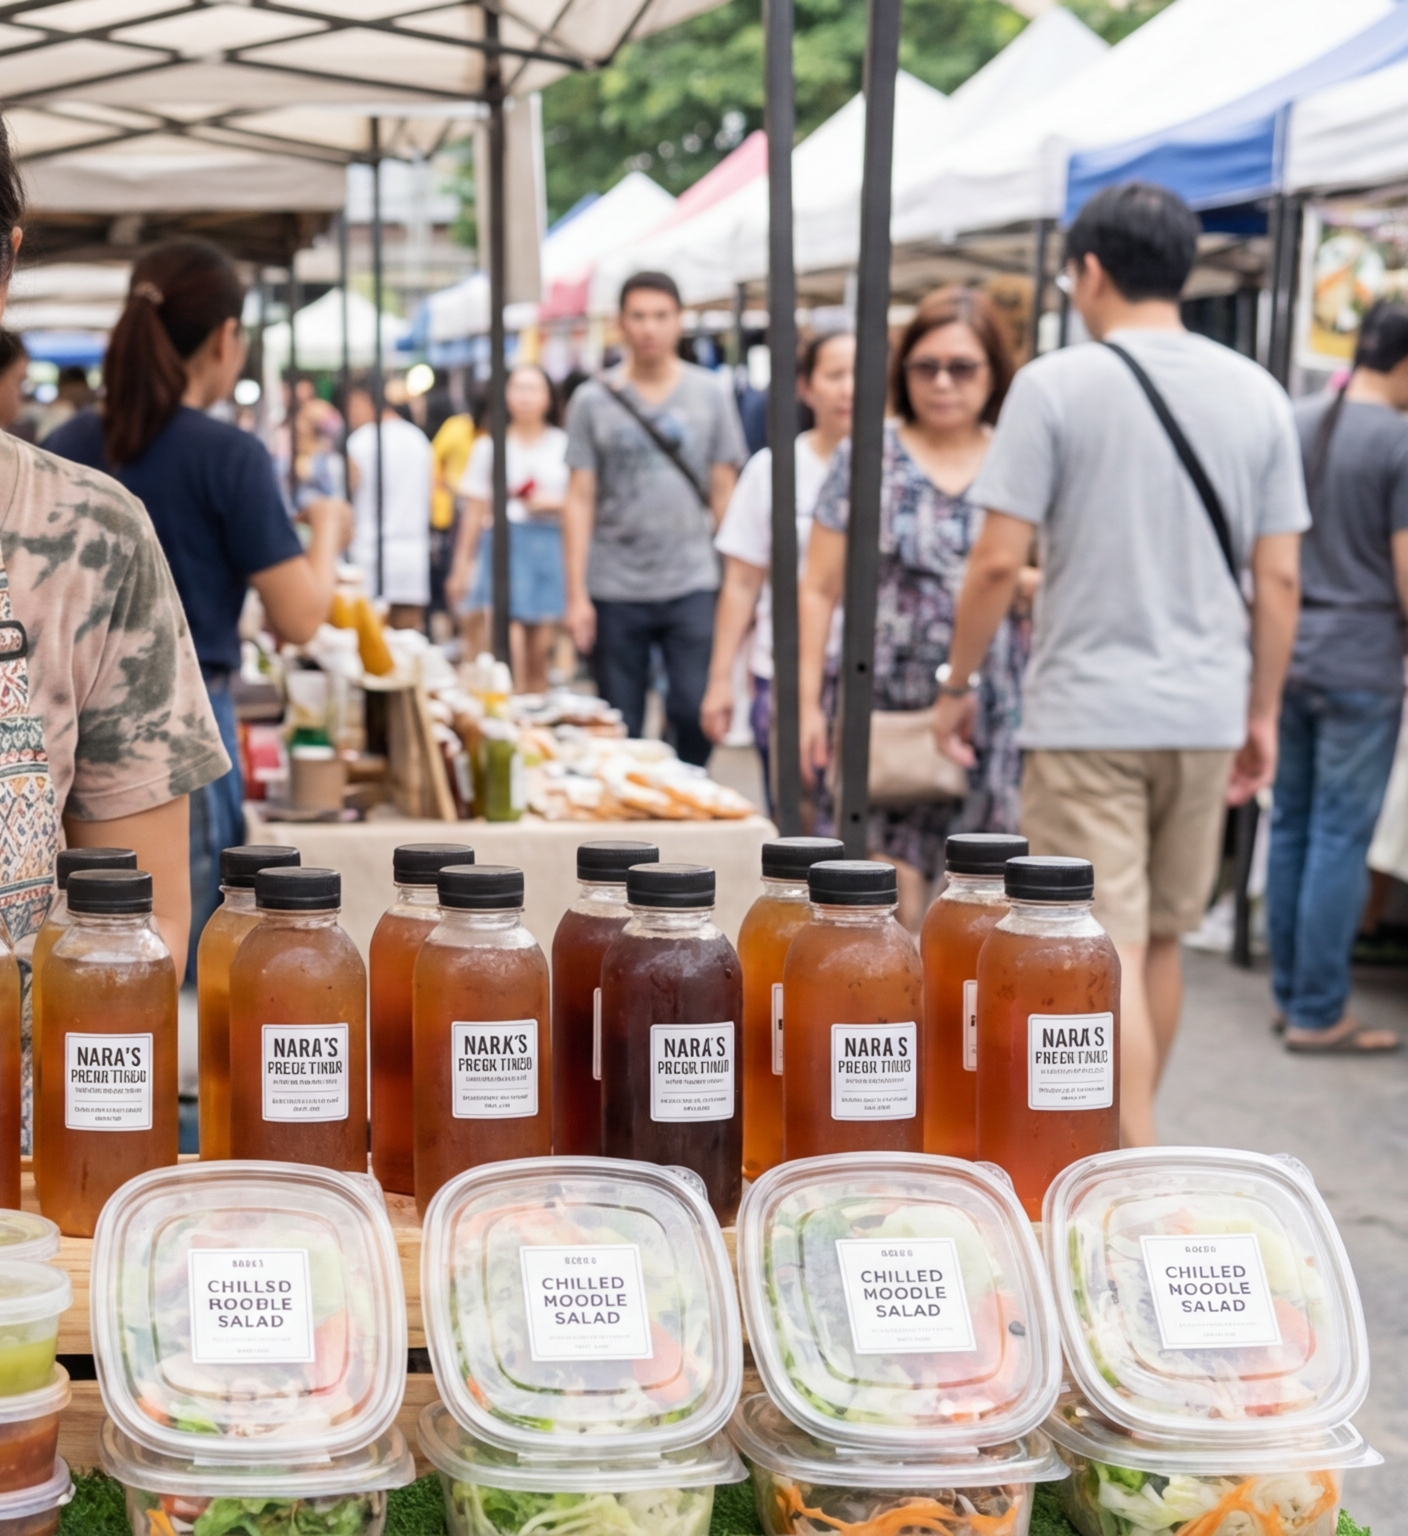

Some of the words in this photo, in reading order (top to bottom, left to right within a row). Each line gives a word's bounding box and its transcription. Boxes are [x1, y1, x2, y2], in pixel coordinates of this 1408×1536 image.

[274, 1038, 338, 1057] NARA'S
[77, 1047, 140, 1066] NARA'S
[861, 1270, 943, 1283] CHILLED
[1165, 1265, 1245, 1278] CHILLED
[542, 1277, 624, 1289] CHILLED
[863, 1287, 946, 1300] MOODLE
[544, 1294, 627, 1307] MOODLE
[1182, 1299, 1245, 1312] SALAD
[876, 1304, 940, 1317] SALAD
[218, 1315, 283, 1327] SALAD
[555, 1312, 620, 1324] SALAD
